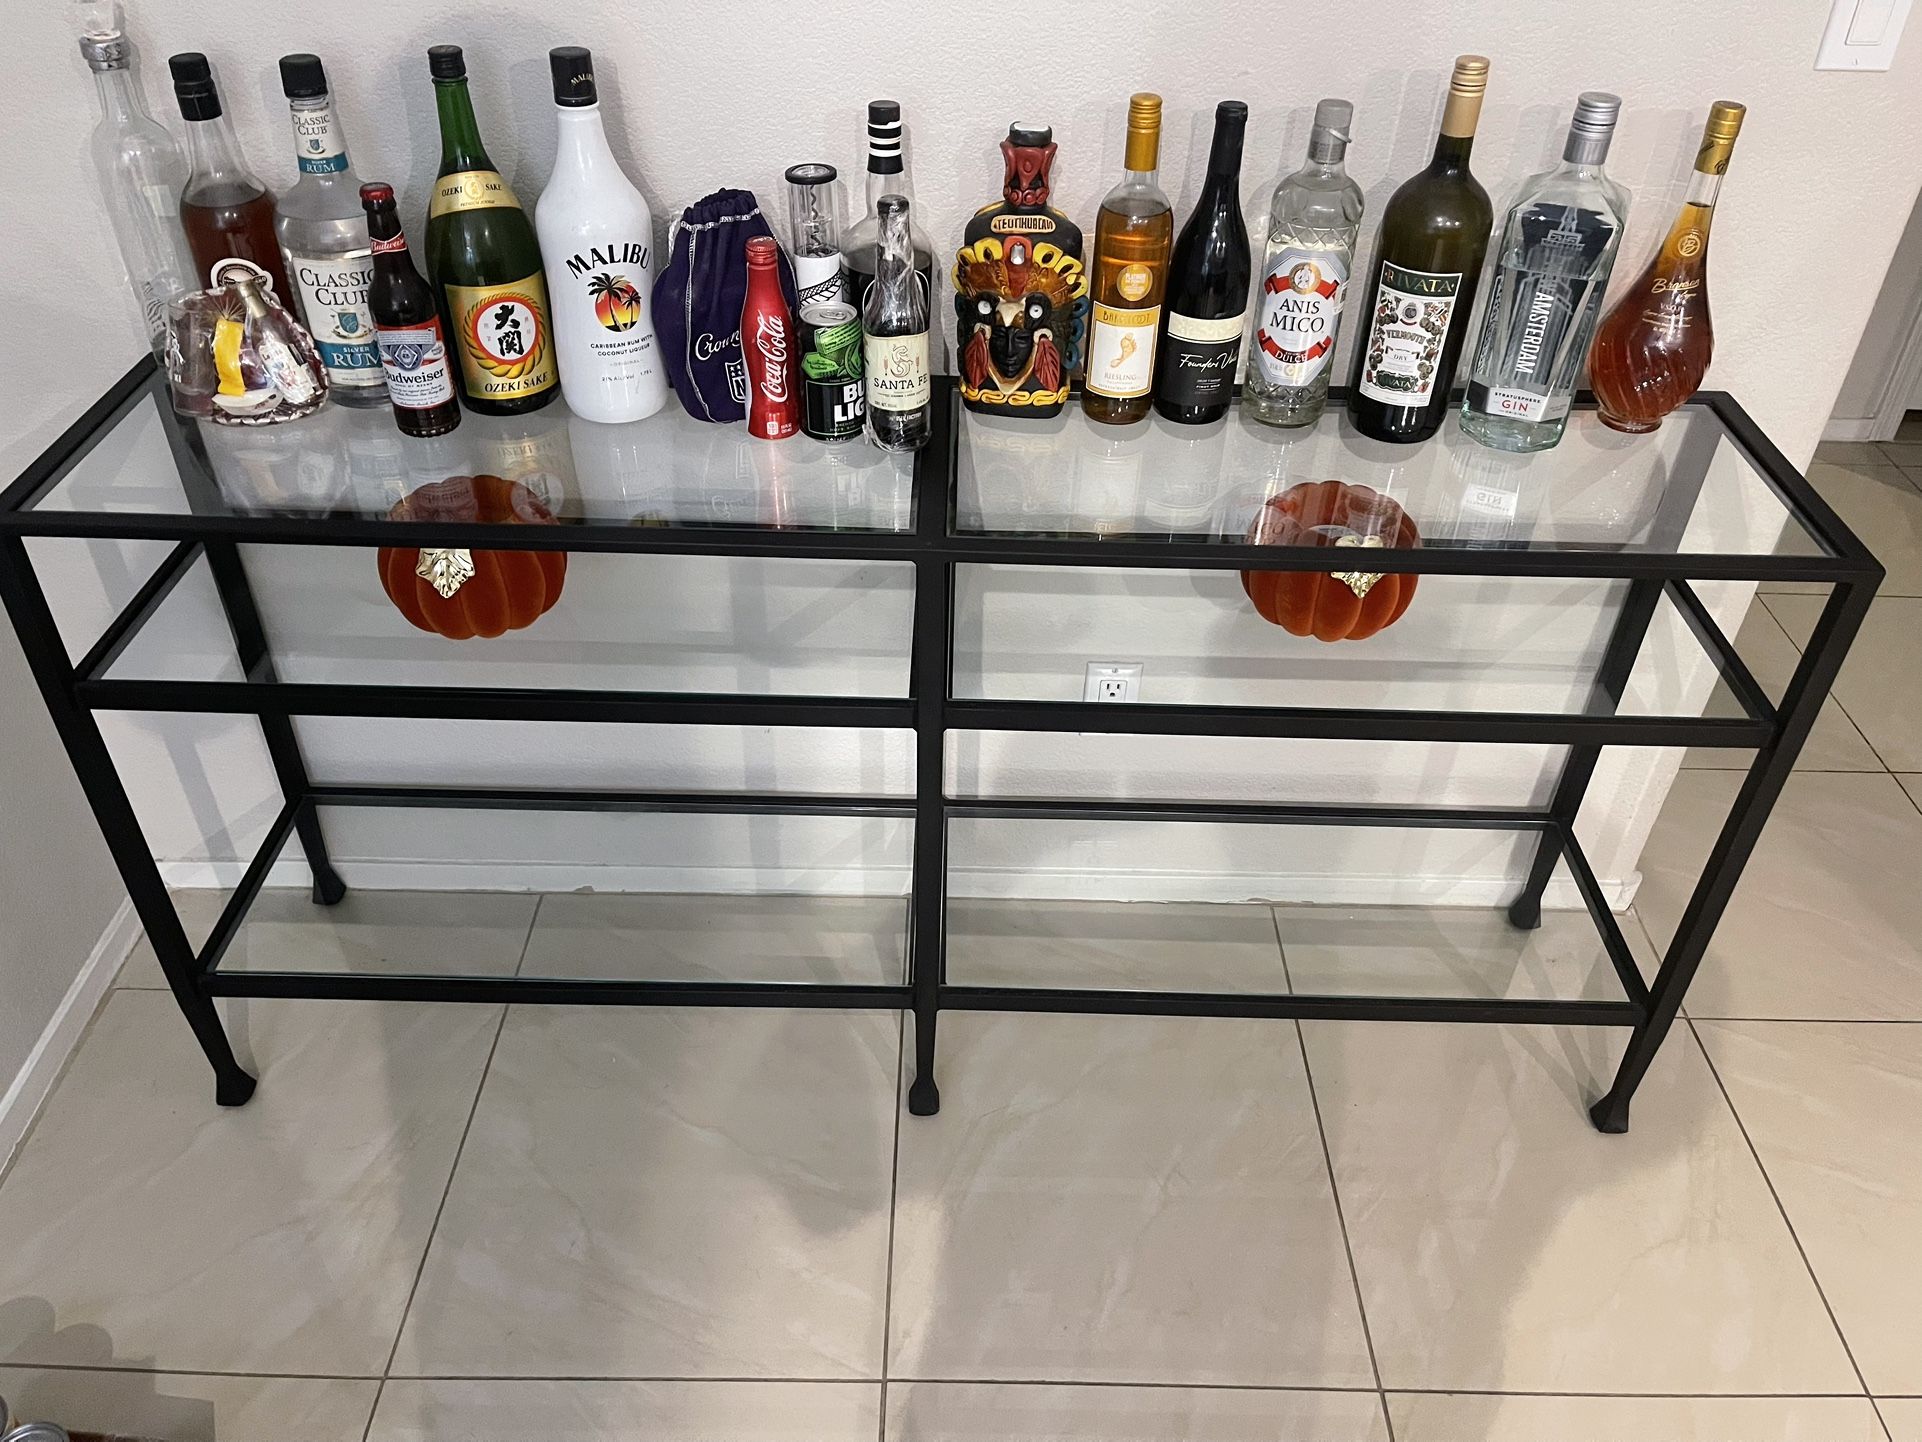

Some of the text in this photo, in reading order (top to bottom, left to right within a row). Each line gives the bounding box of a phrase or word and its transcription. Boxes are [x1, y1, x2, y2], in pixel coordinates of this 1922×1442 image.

[292, 114, 330, 126] CLASSIC
[297, 125, 328, 135] CLUB
[306, 163, 335, 173] RUM
[441, 183, 502, 197] OZEKI SAKE
[565, 243, 651, 280] MALIBU
[1386, 269, 1453, 293] RIVATA
[1279, 298, 1321, 314] ANIS
[1269, 312, 1324, 333] MICO
[641, 334, 654, 343] WITH
[1385, 329, 1427, 344] VERMOUTH
[1514, 291, 1555, 374] AMSTERDAM
[597, 343, 650, 357] COCONUT LIQUEUR
[695, 330, 741, 361] Crown
[1274, 350, 1308, 363] DULCE
[1393, 353, 1408, 361] DRY
[484, 372, 548, 393] OZEKI SAKE
[873, 373, 928, 390] SANTA FE
[1104, 372, 1137, 381] RIESLING
[1501, 399, 1529, 412] GIN
